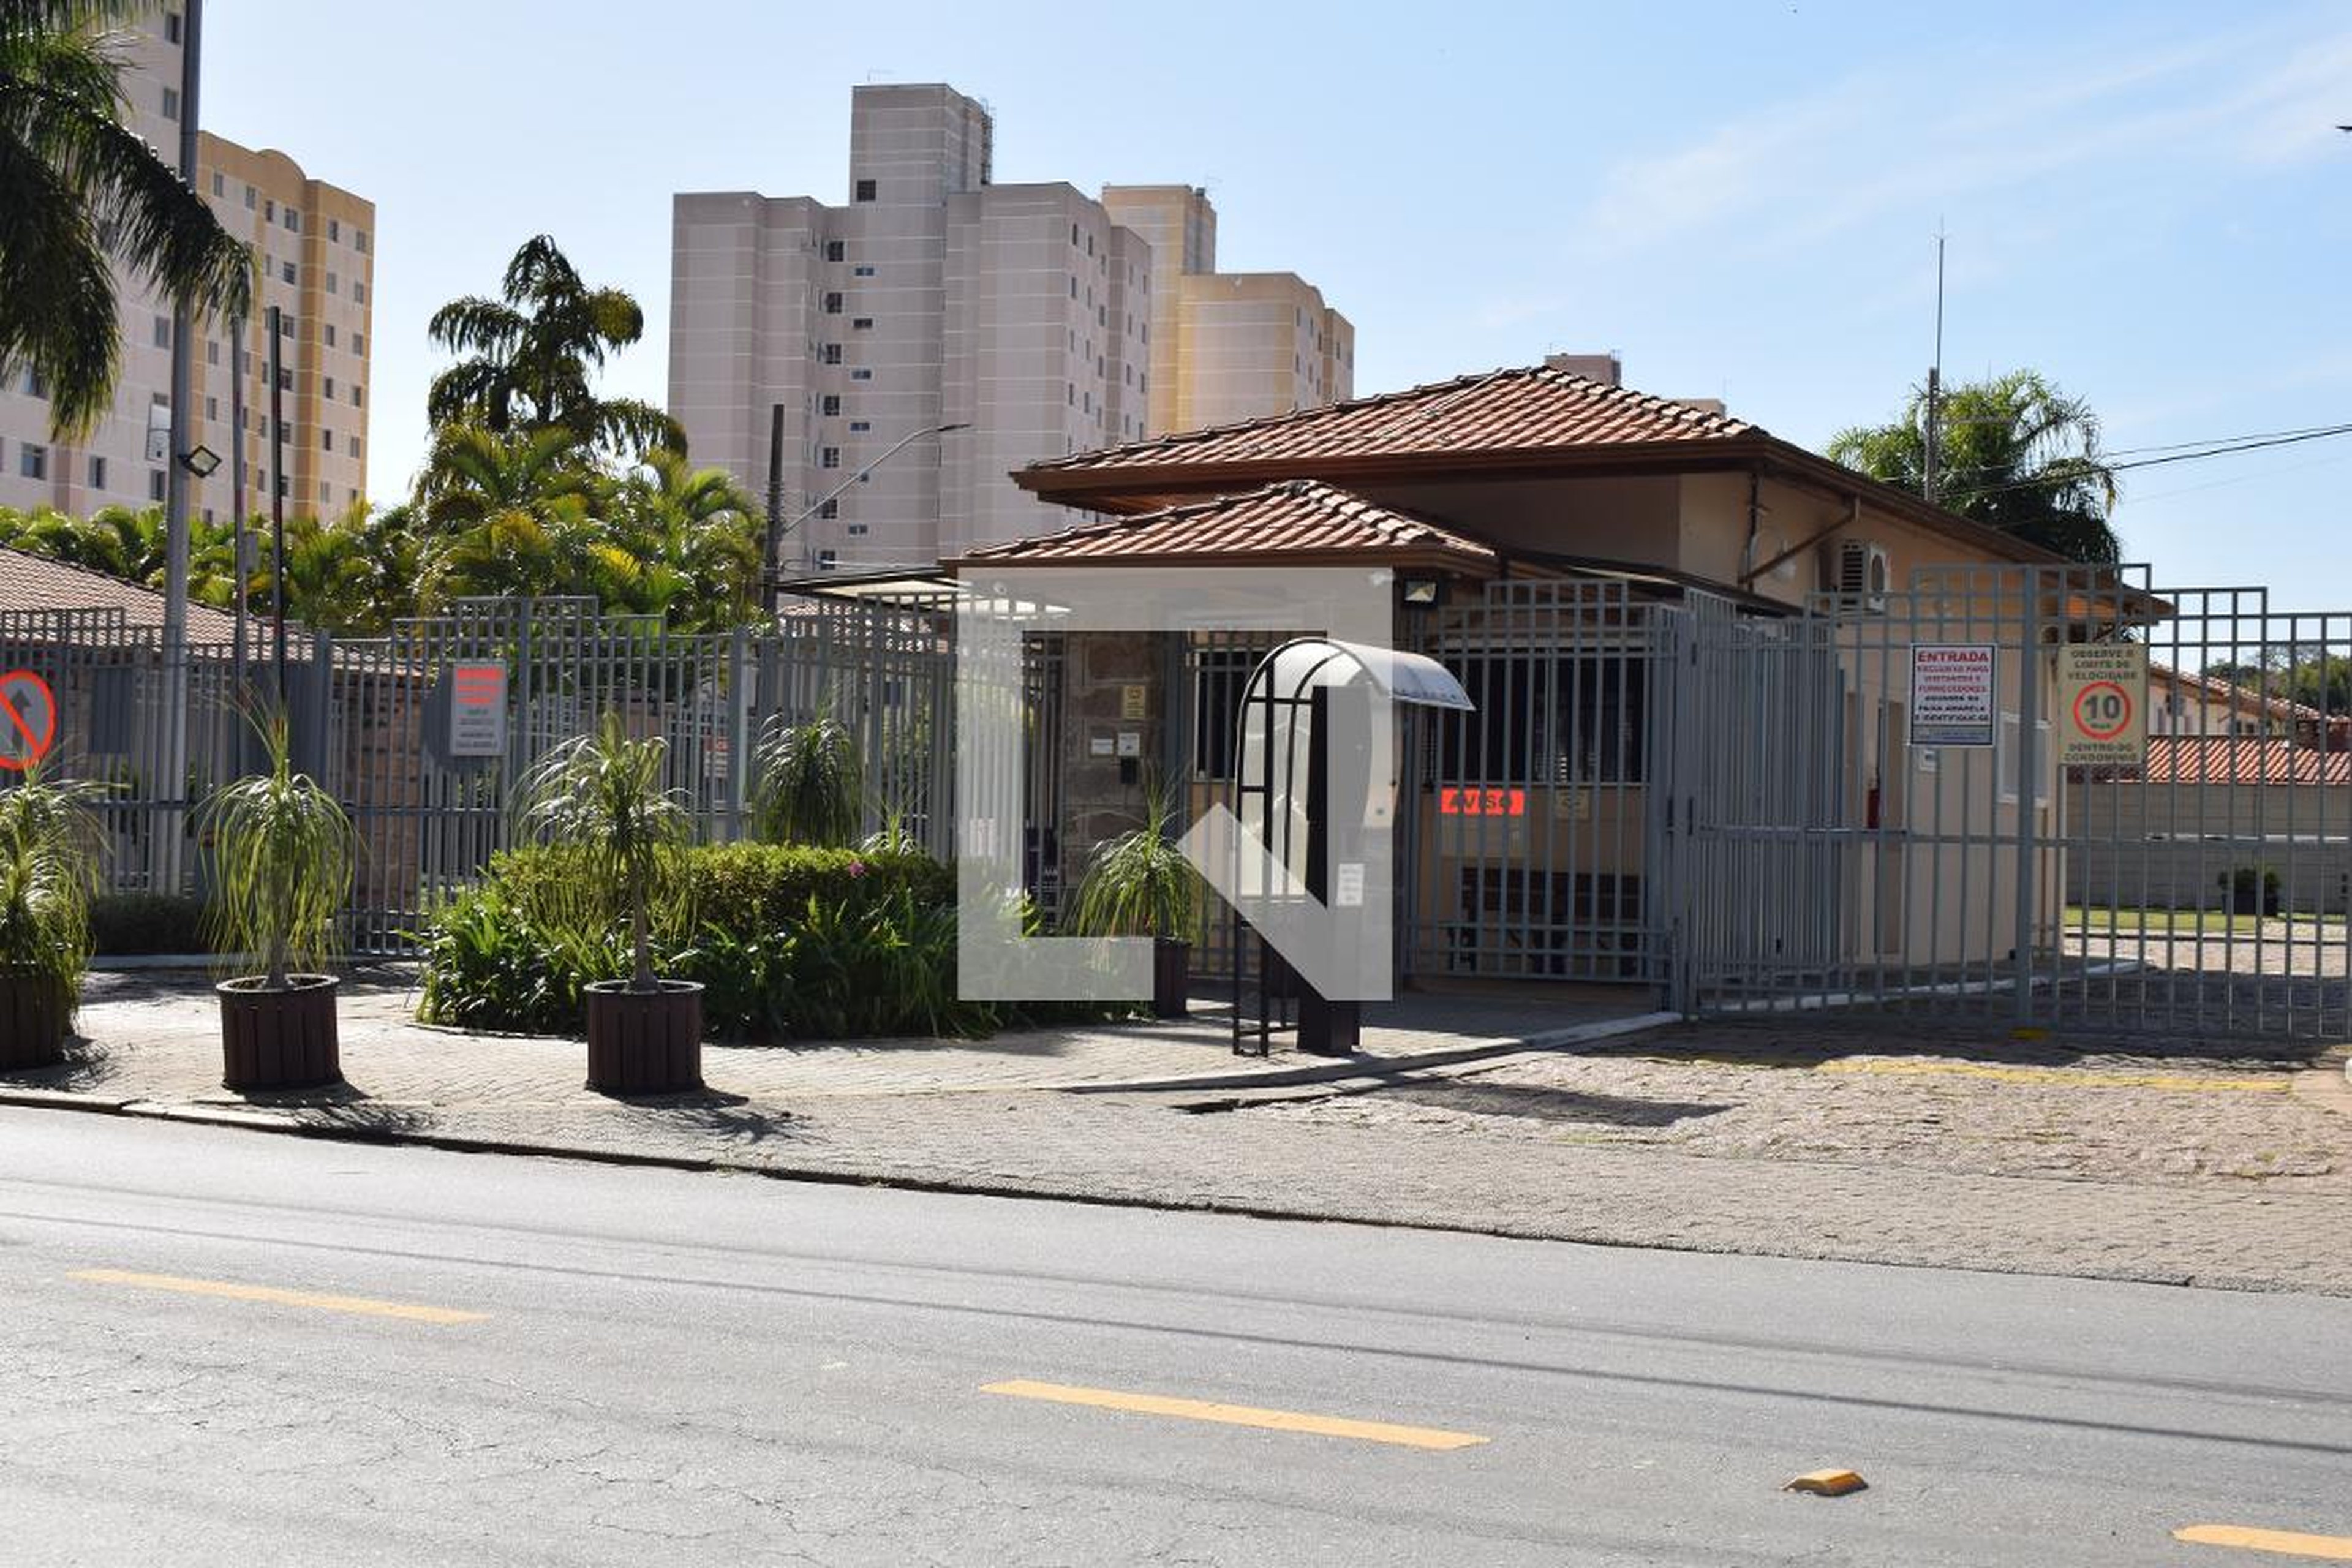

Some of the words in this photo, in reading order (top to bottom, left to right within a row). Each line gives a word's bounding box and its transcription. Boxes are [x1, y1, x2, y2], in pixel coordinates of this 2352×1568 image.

[1918, 651, 1988, 662] ENTRADA
[2072, 649, 2122, 658] OBSERVE
[2068, 671, 2137, 680] VELOCIDADE
[2084, 695, 2120, 719] 10
